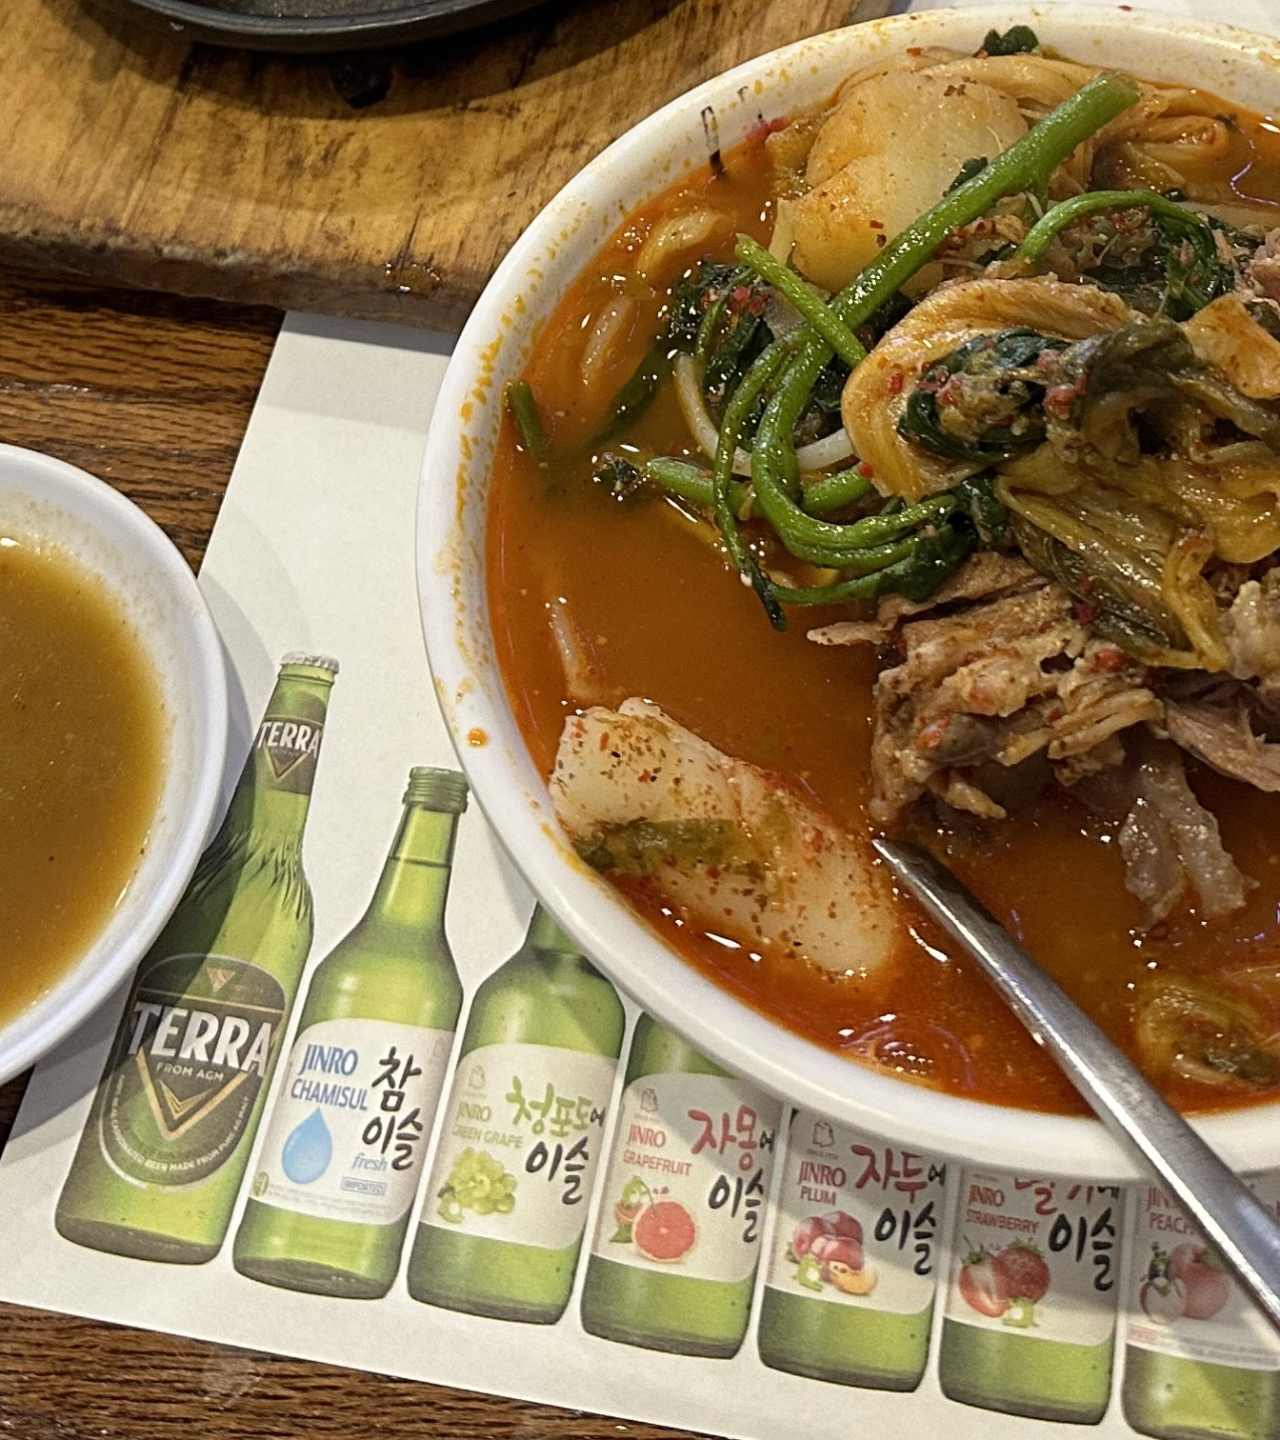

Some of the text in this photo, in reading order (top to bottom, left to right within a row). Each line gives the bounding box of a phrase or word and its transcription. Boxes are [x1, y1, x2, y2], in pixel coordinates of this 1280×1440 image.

[257, 721, 320, 758] TERRA
[127, 1001, 272, 1077] TERRA
[156, 1063, 224, 1081] FROM AGM
[298, 1044, 359, 1077] JINRO
[291, 1077, 369, 1111] CHAMISUL
[371, 1046, 423, 1113] 참
[456, 1101, 492, 1123] JINRO
[505, 1075, 607, 1137] 청포도에
[361, 1107, 424, 1172] 이슬
[483, 1130, 524, 1148] GRAPE
[627, 1123, 667, 1148] JINRO
[687, 1104, 776, 1171] 자몽에
[351, 1152, 389, 1172] fresh
[525, 1135, 589, 1206] 이슬
[623, 1149, 693, 1177] GRAPEFRUIT
[798, 1161, 847, 1188] JINRO
[850, 1143, 947, 1205] 자두에
[708, 1168, 764, 1243] 이슬
[799, 1186, 837, 1206] PLUM
[968, 1184, 1005, 1207] JINRO
[874, 1200, 937, 1276] 이슬
[965, 1209, 1040, 1235] STRAWBERRY
[1048, 1207, 1115, 1292] 이슬
